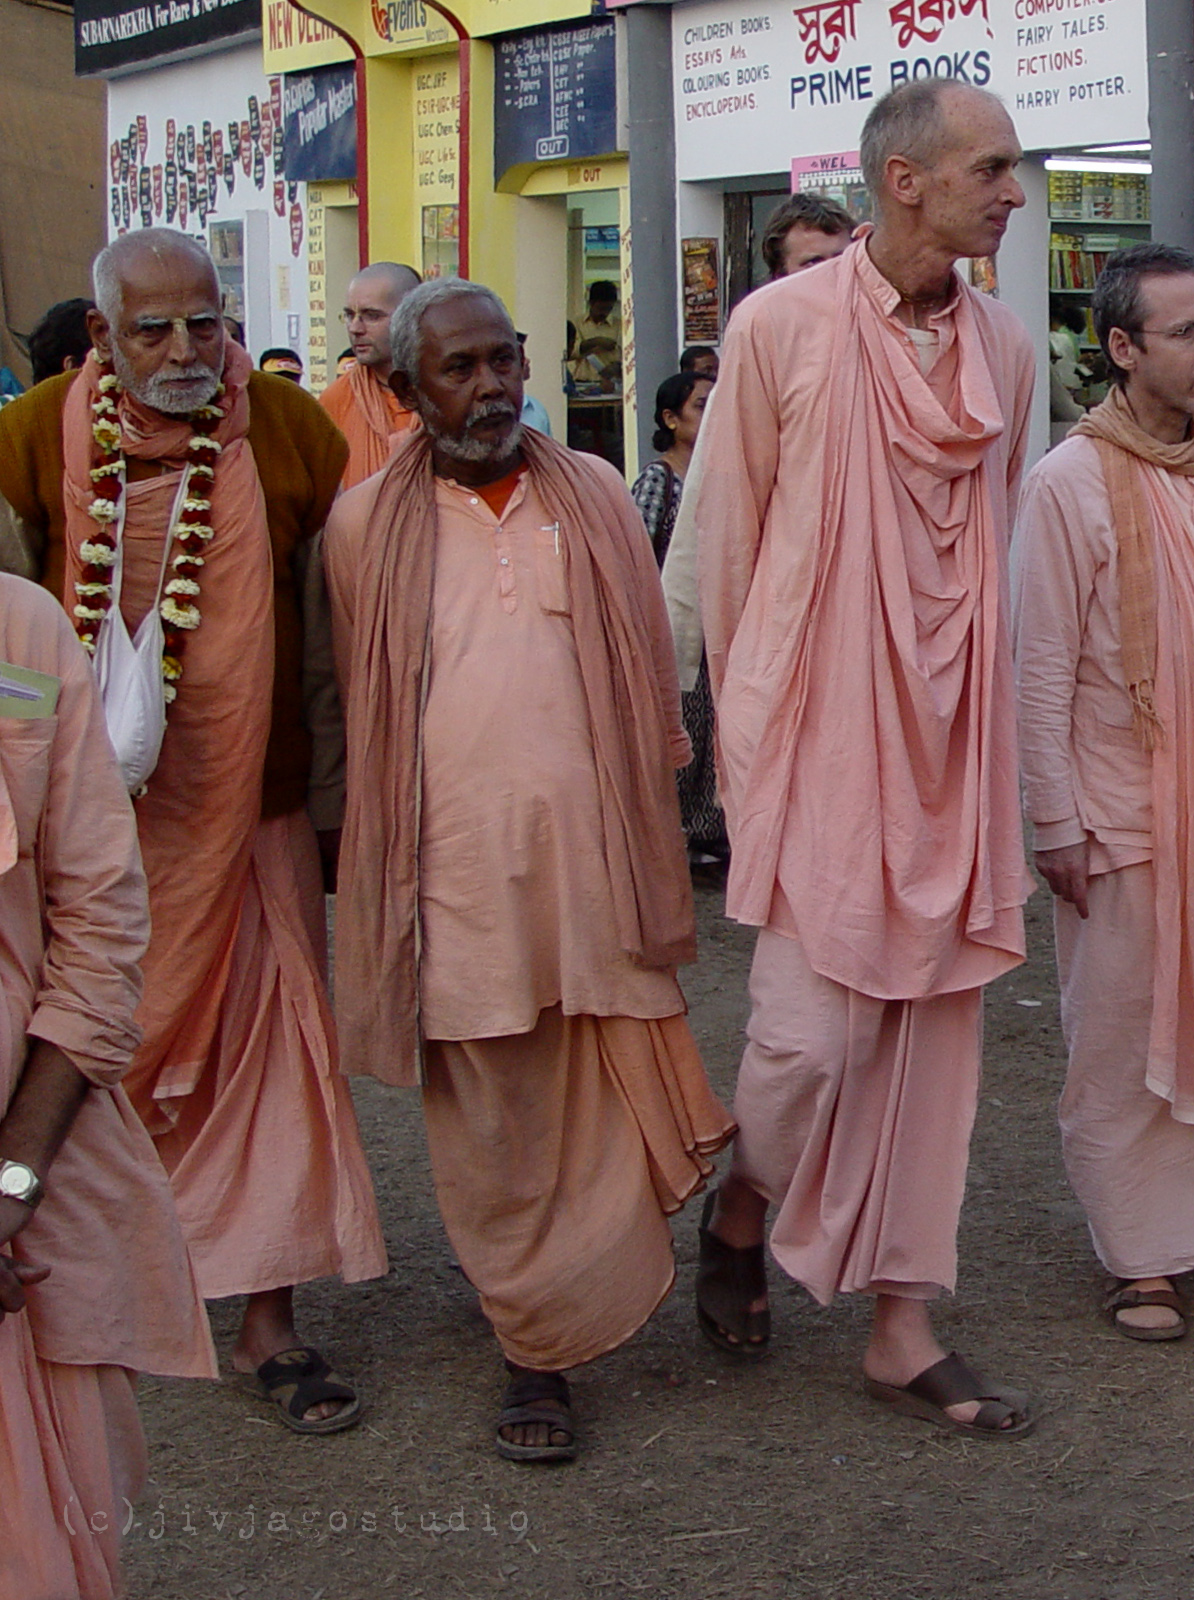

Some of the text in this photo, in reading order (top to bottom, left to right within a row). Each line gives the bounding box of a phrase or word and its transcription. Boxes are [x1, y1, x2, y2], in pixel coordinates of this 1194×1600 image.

[81, 6, 153, 47] SUBARNAREKHA
[155, 4, 170, 28] For
[170, 1, 190, 25] Rare
[269, 1, 293, 51] NEW
[684, 21, 734, 45] CHILDREN
[1017, 25, 1053, 46] FAIRY
[685, 48, 722, 70] ESSAYS
[1017, 48, 1087, 76] FICTIONS.
[682, 71, 730, 94] COLOURING
[791, 50, 991, 109] PRIME BOOKS
[1016, 76, 1131, 109] HARRY POTTER.
[540, 140, 563, 154] OUT
[583, 168, 601, 182] OUT
[309, 208, 323, 221] CAT
